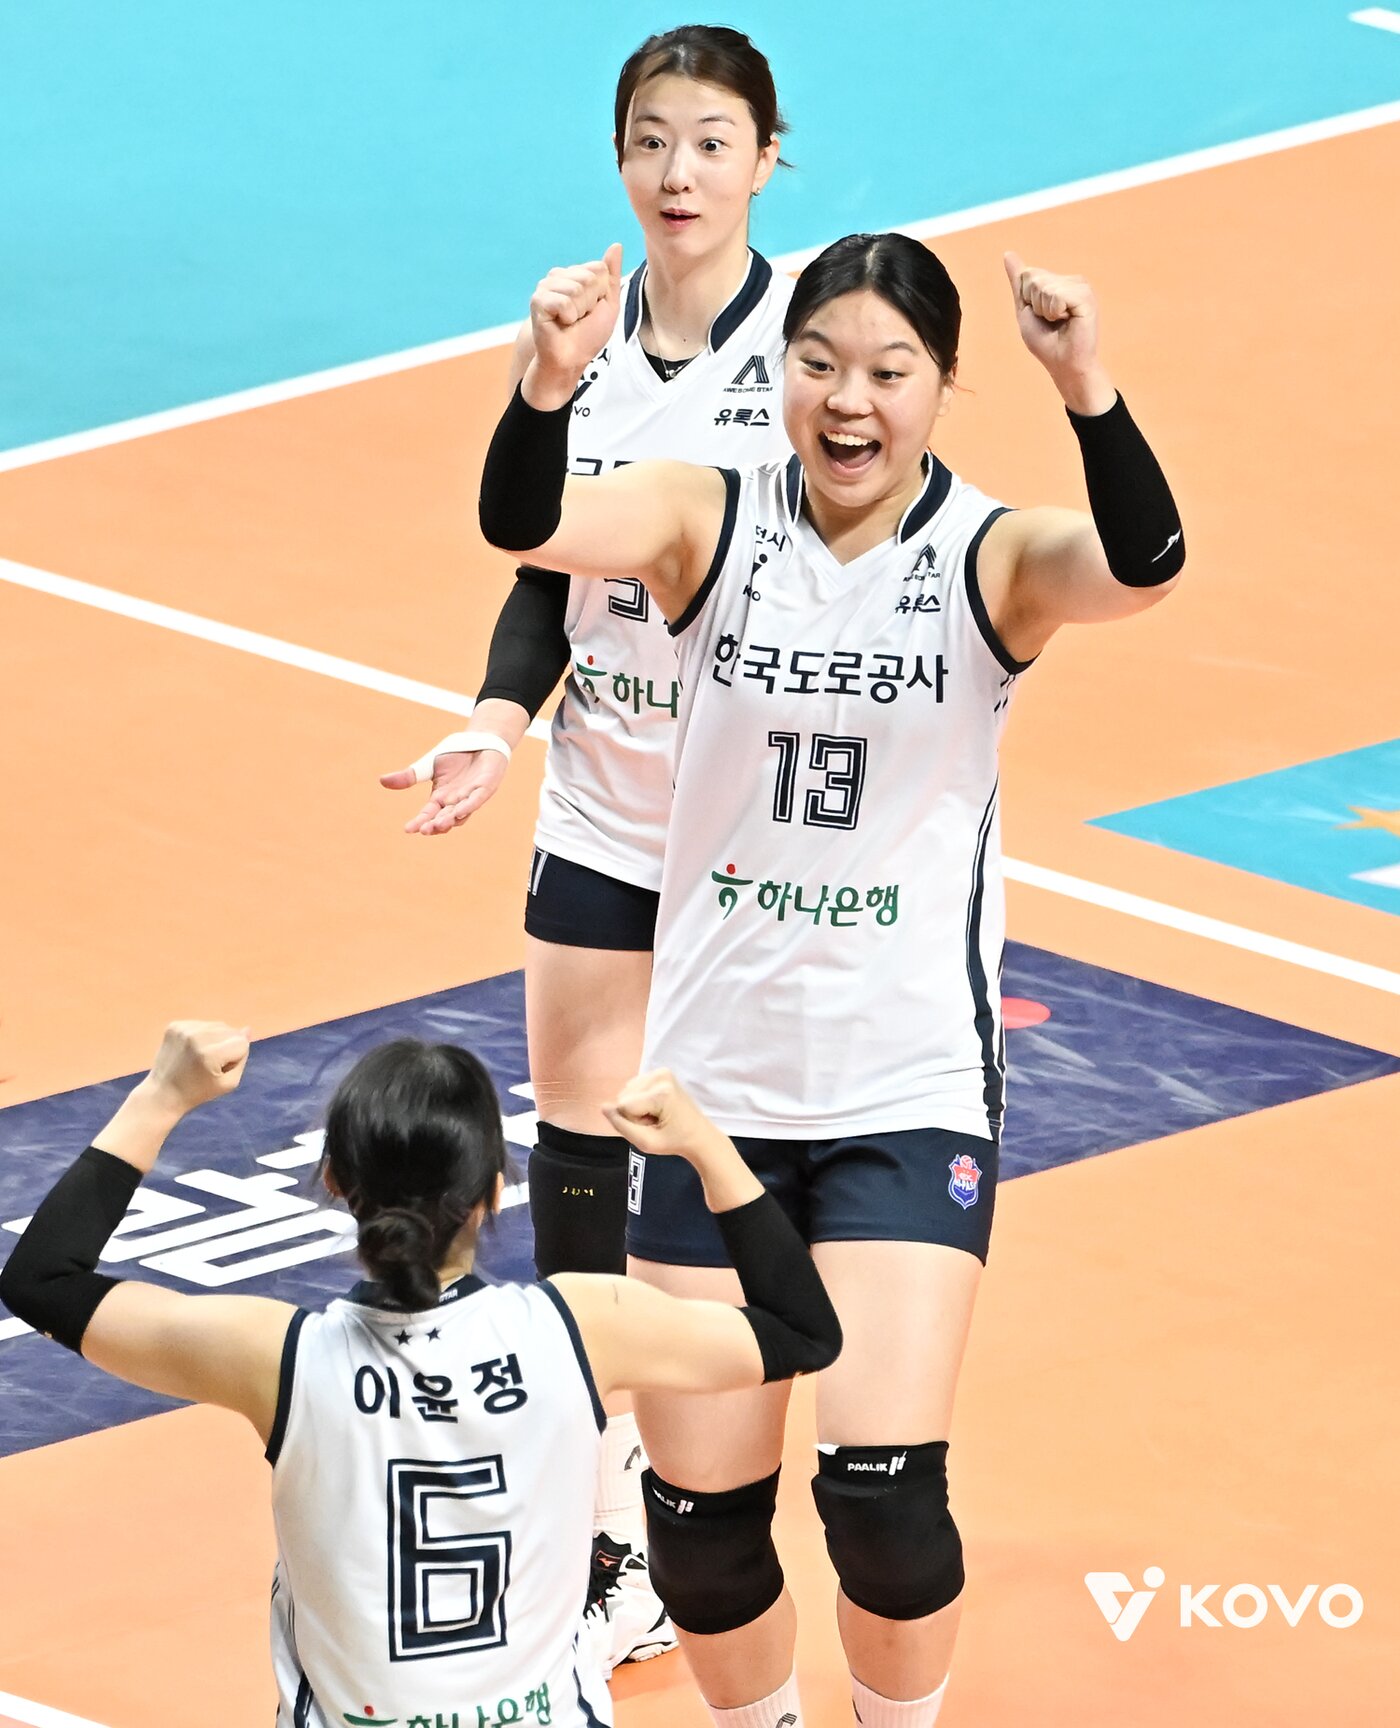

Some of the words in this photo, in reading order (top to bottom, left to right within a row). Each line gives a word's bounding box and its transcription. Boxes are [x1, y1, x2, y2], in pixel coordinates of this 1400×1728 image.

[574, 406, 590, 418] VO
[714, 408, 770, 426] 유록스
[712, 633, 949, 703] 한국도로공사
[612, 672, 679, 718] 하나
[768, 731, 868, 830] 13
[758, 880, 899, 927] 하나은행
[354, 1353, 528, 1423] 이윤정
[847, 1463, 888, 1471] PAALIK
[387, 1454, 513, 1662] 6
